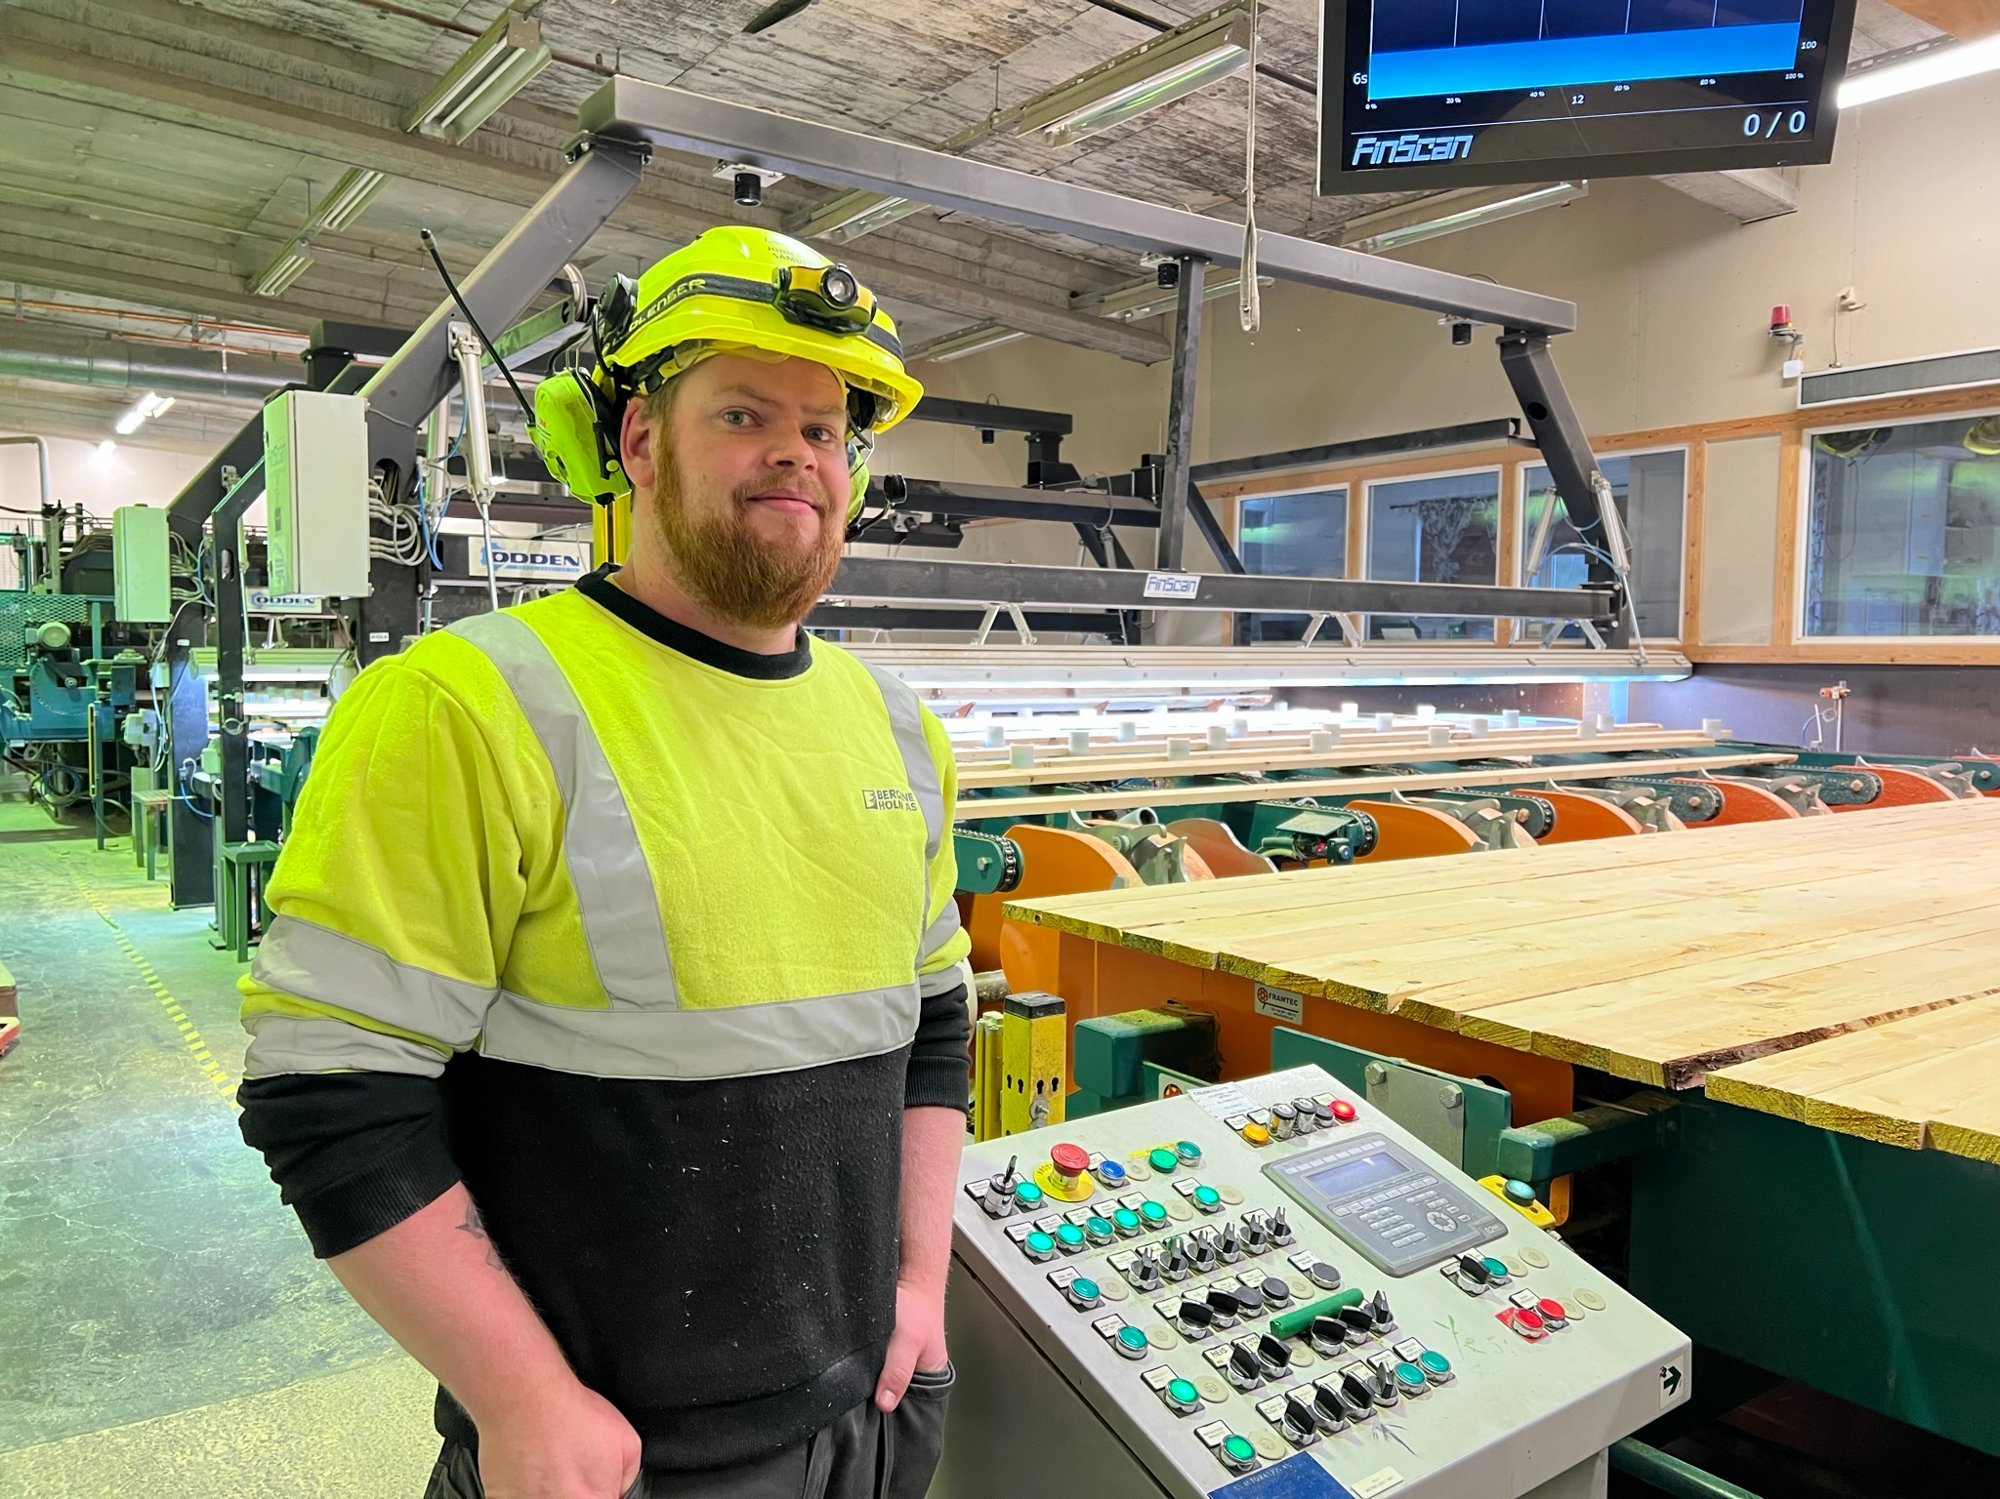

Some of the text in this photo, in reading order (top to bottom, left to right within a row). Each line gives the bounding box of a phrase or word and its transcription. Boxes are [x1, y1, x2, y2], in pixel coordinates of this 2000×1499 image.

[1800, 40, 1817, 50] 100
[1352, 72, 1368, 85] 6s
[1571, 94, 1585, 105] 12
[1743, 110, 1806, 139] 0 / 0
[1351, 134, 1473, 166] FinScan
[1147, 576, 1197, 593] FinScan
[905, 802, 918, 812] AS
[1268, 992, 1299, 1007] FRAMTEC
[1210, 1347, 1228, 1358] HEIS
